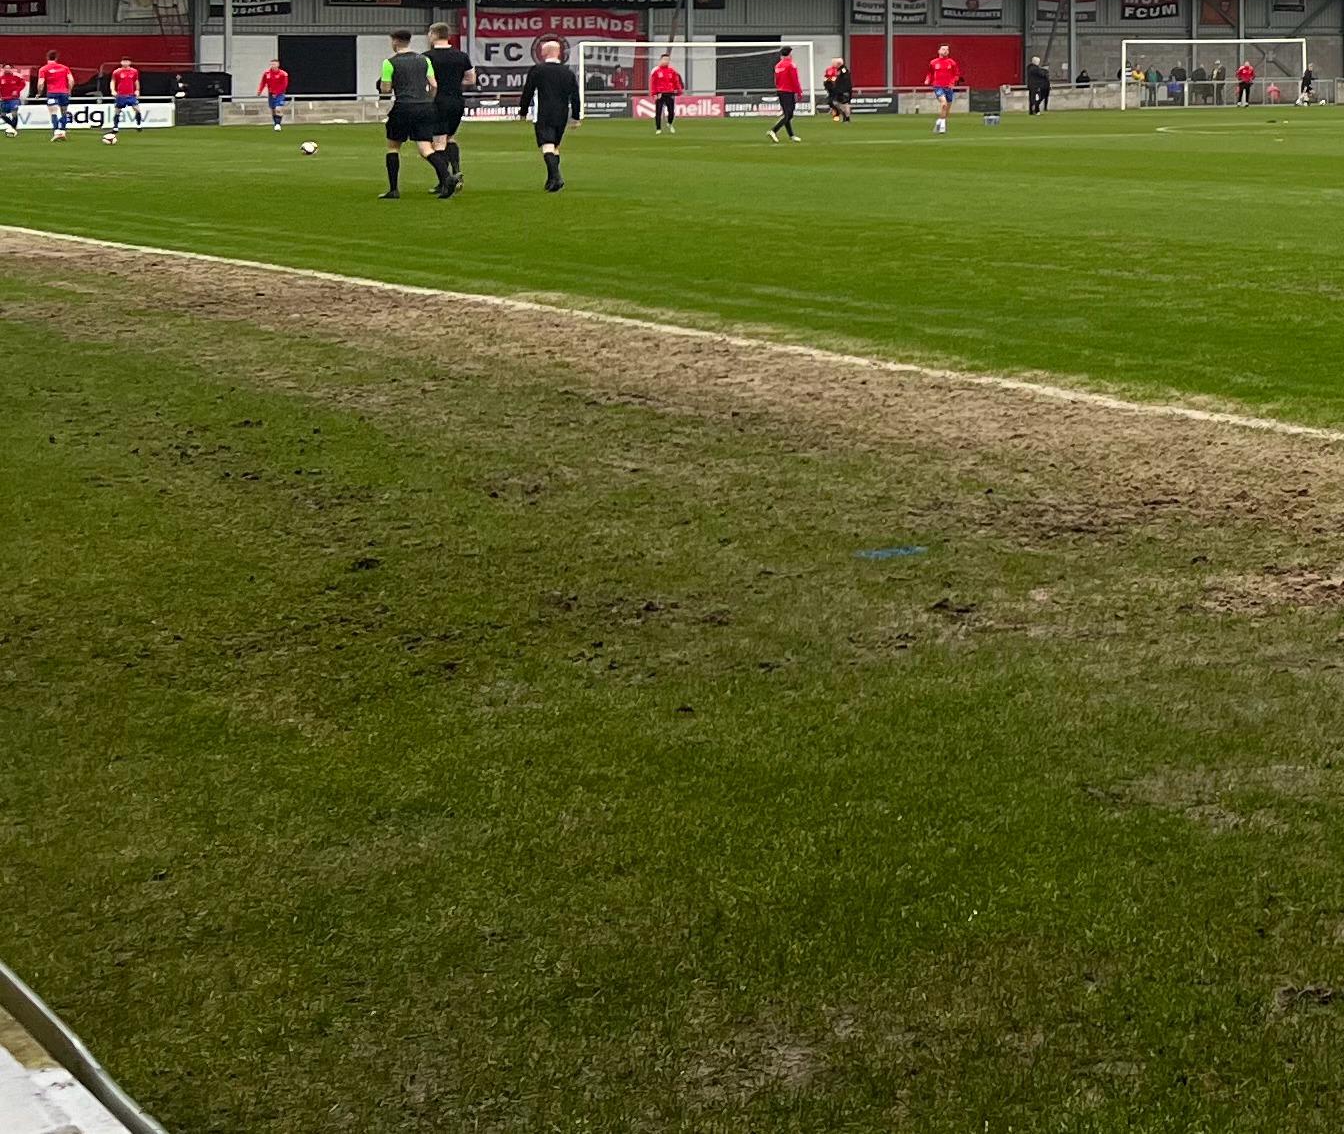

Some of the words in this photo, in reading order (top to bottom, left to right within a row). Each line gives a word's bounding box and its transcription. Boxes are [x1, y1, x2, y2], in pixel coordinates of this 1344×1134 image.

[1124, 4, 1177, 17] FCUM
[463, 16, 543, 30] AKING
[550, 16, 634, 32] FRIENDS
[485, 43, 523, 62] FC
